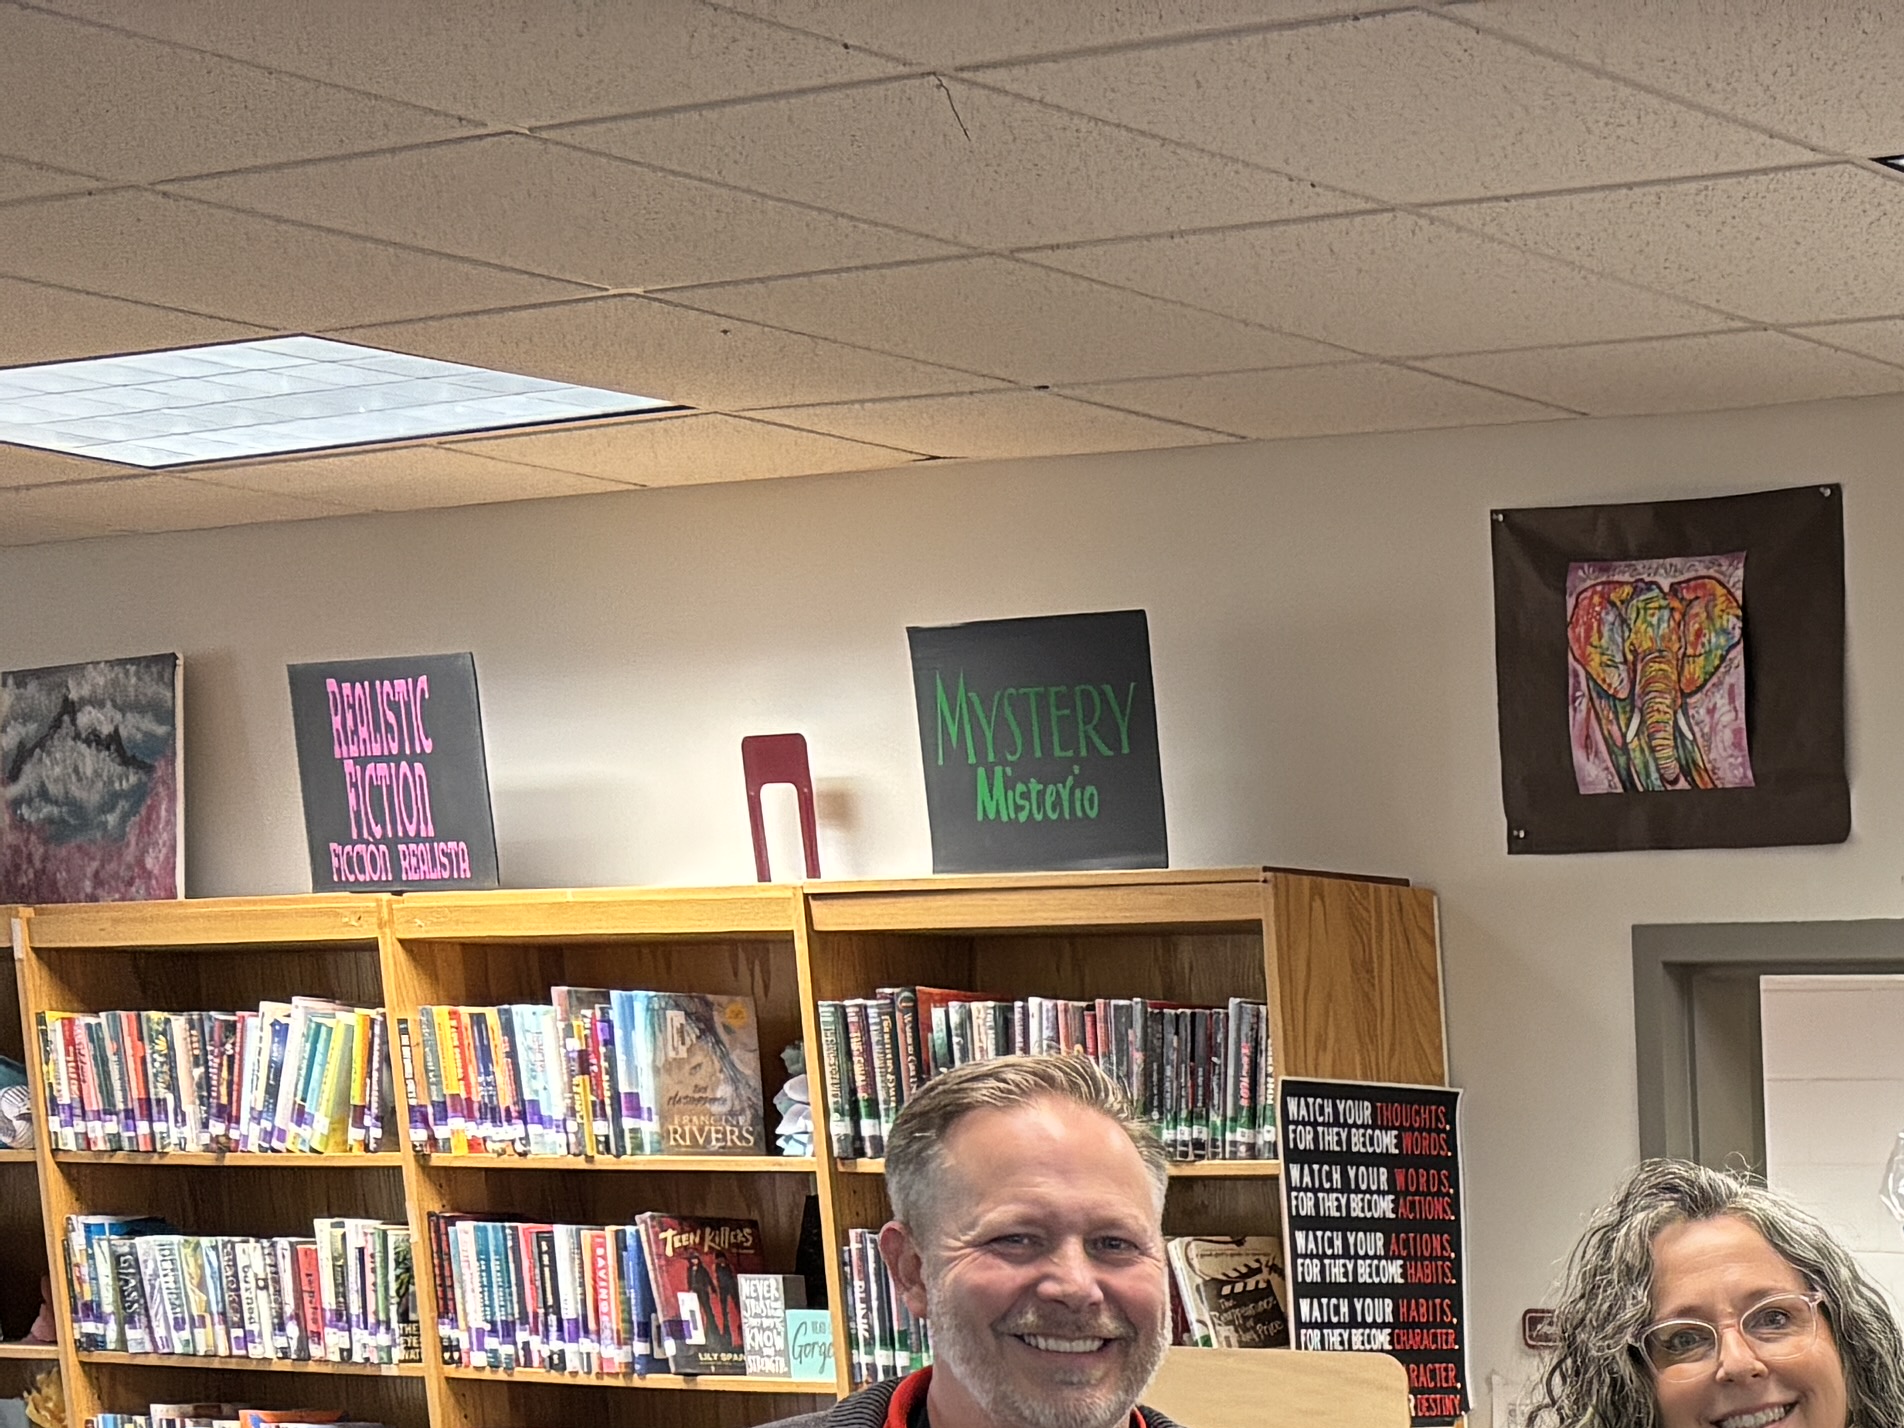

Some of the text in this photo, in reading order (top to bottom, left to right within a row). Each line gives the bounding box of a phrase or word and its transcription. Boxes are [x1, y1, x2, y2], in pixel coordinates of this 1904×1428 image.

[325, 674, 433, 759] REALISTIC
[935, 667, 1137, 766] MYSTERY
[343, 758, 435, 840] FICTION
[976, 764, 1099, 823] Misterio
[398, 840, 472, 881] REALISTA
[1286, 1096, 1334, 1123] WATCH
[1336, 1099, 1372, 1126] YOUR
[667, 1124, 755, 1147] RIVERS
[1288, 1124, 1315, 1151] FOR
[1316, 1126, 1348, 1152] THEY
[1351, 1128, 1400, 1154] BECOME
[1288, 1163, 1341, 1189] WATCH
[1347, 1165, 1388, 1191] YOUR
[1290, 1191, 1315, 1217] FOR
[1317, 1193, 1348, 1217] THEY
[1350, 1194, 1396, 1219] BECOME
[658, 1227, 701, 1257] TEEN
[1294, 1230, 1342, 1255] WATCH
[1347, 1231, 1385, 1256] YOUR
[1296, 1258, 1321, 1283] FOR
[1323, 1258, 1354, 1283] THEY
[1357, 1259, 1405, 1284] BECOME
[740, 1277, 780, 1300] NEVER
[1299, 1298, 1349, 1323] WATCH
[1354, 1298, 1394, 1323] YOUR
[744, 1328, 785, 1351] KNOW
[1300, 1328, 1321, 1350] FOR
[1323, 1328, 1350, 1350] THEY
[1351, 1328, 1393, 1350] BECOME
[1404, 1363, 1462, 1390] RACTER,
